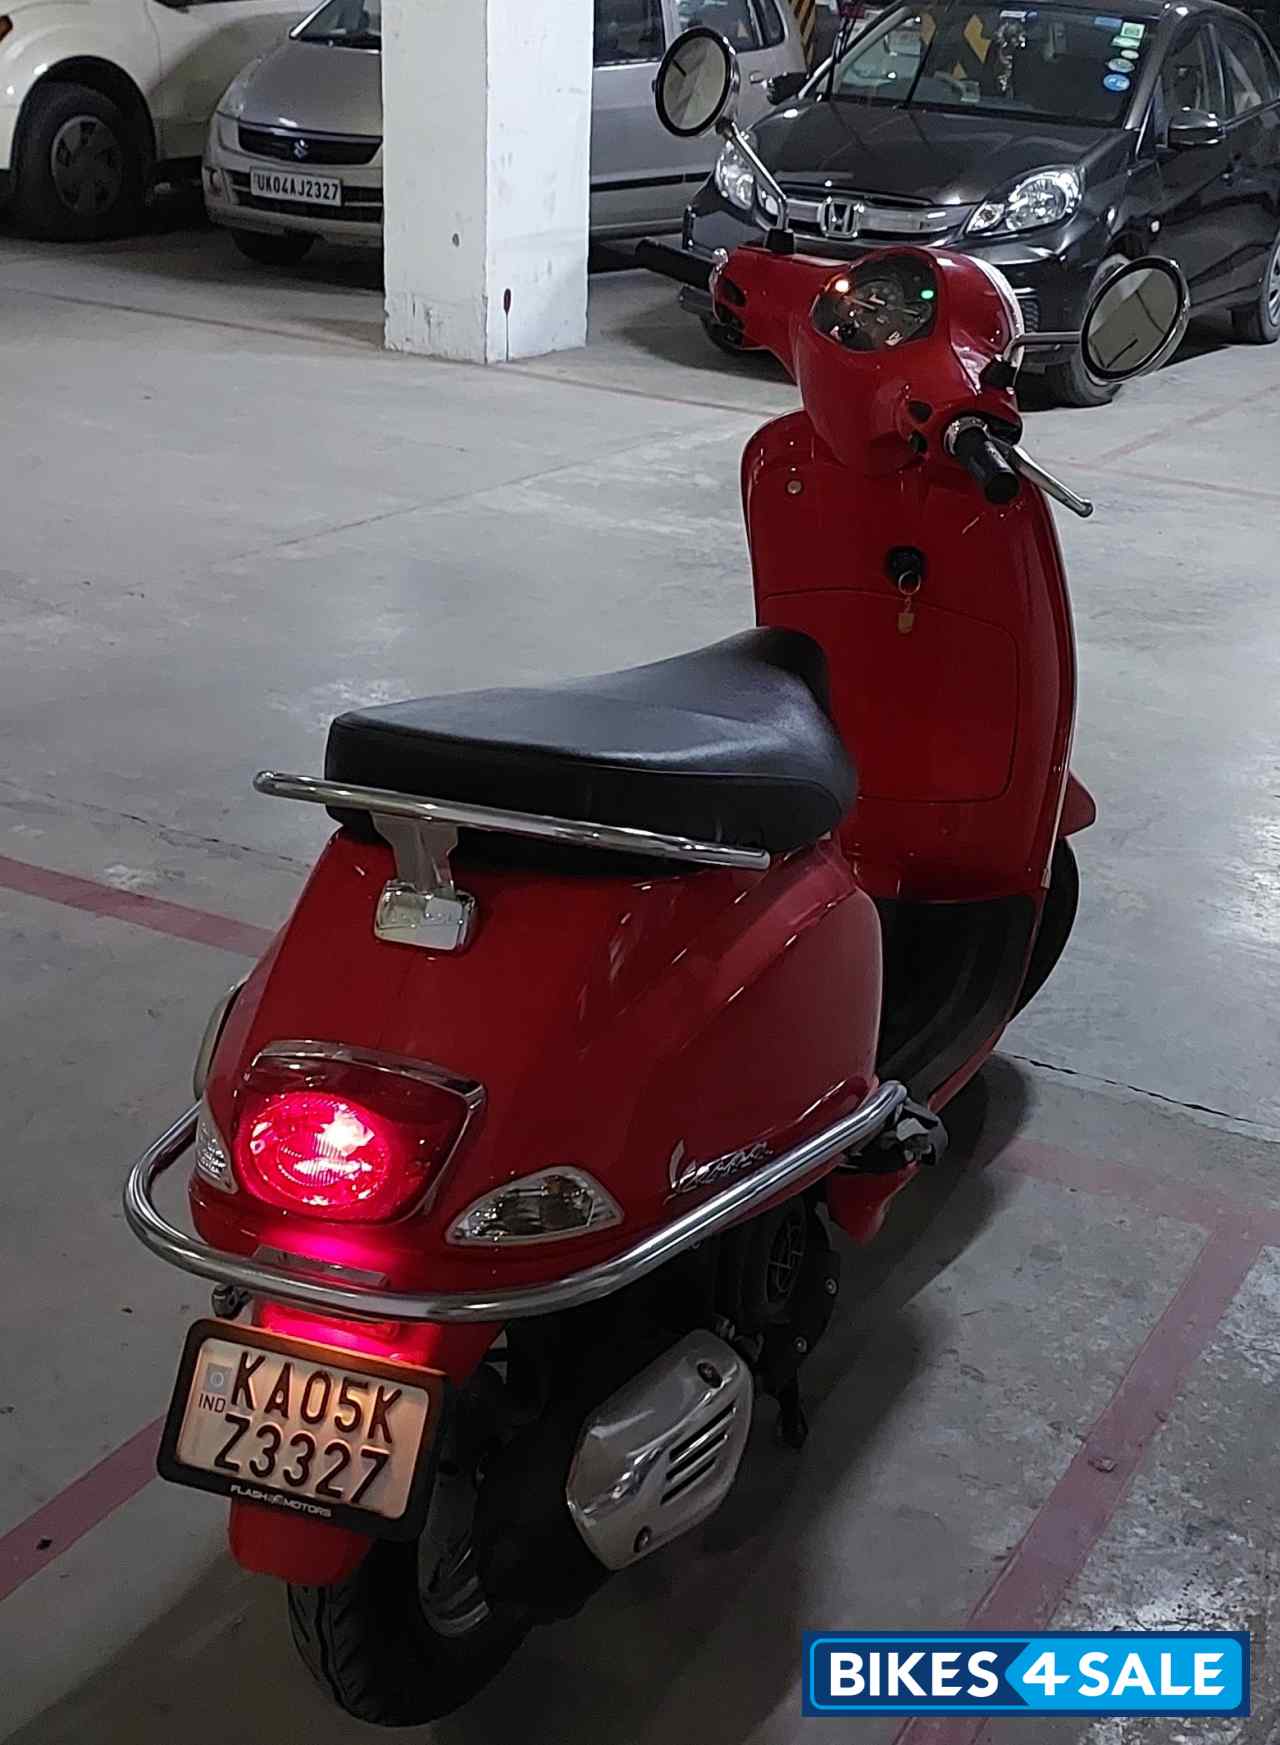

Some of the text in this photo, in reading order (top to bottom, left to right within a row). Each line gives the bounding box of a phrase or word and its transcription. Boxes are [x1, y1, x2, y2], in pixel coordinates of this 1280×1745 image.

[256, 173, 339, 201] UK04AJ2327
[198, 1392, 227, 1414] IND
[230, 1351, 402, 1445] KA05K
[213, 1412, 391, 1504] Z3327
[230, 1484, 332, 1518] FLASH MOTORS
